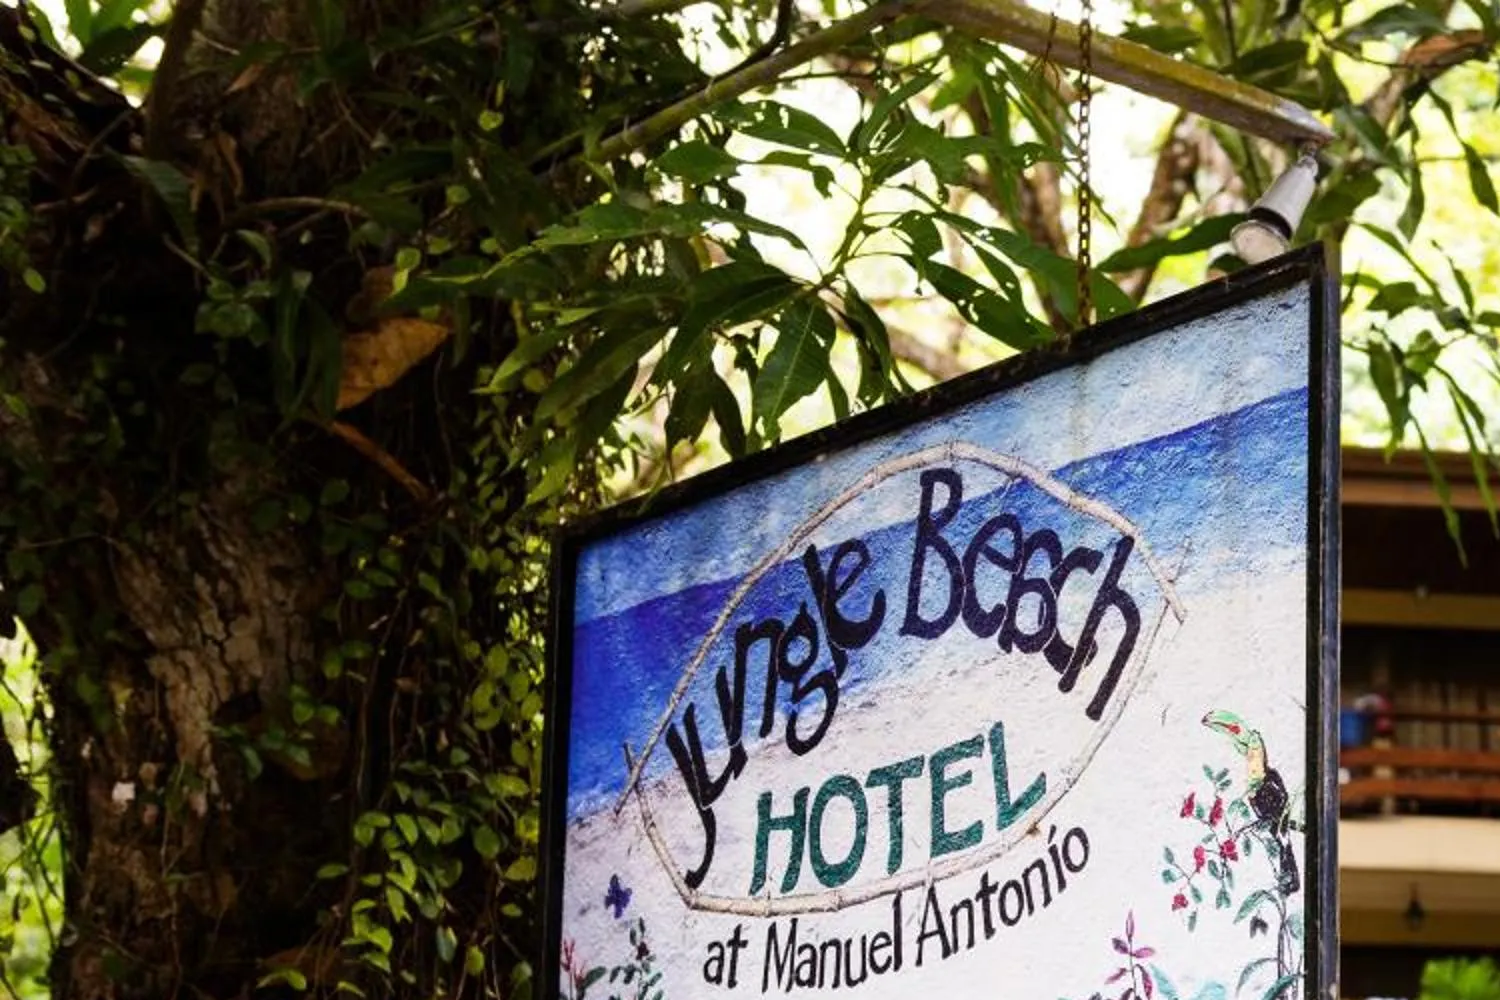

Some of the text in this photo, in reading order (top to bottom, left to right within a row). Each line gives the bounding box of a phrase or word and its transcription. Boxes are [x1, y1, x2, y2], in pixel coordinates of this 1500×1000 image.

[666, 467, 1141, 888] Jungle Beach
[749, 722, 1047, 895] HOTEL
[703, 923, 748, 989] at
[762, 890, 902, 993] Manuel
